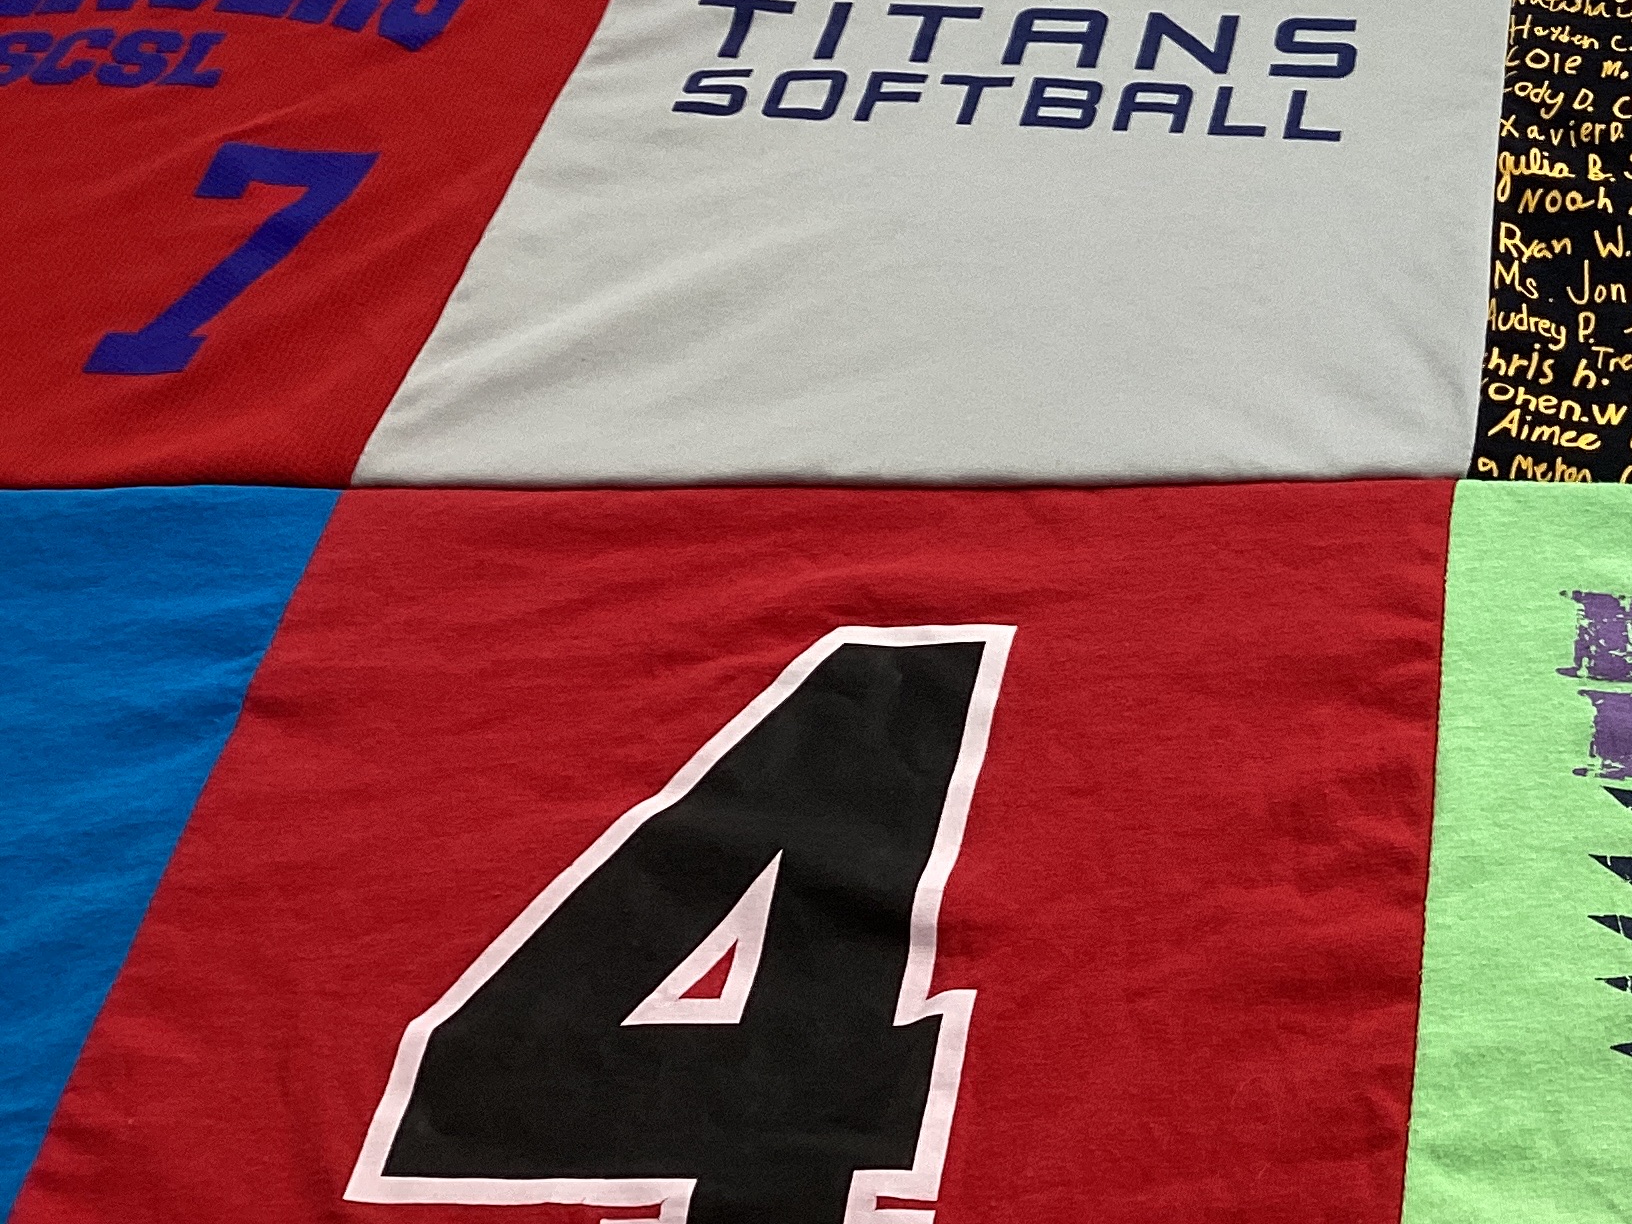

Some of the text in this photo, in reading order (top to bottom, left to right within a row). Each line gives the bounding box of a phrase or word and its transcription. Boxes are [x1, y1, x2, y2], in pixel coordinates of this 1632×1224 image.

[0, 28, 228, 88] SCSL
[671, 68, 1343, 142] SOFTBALL
[1518, 186, 1613, 214] Noah
[82, 141, 381, 376] 7
[1499, 221, 1572, 263] Ryan
[1487, 408, 1602, 451] Aimee
[343, 623, 1018, 1224] 4
